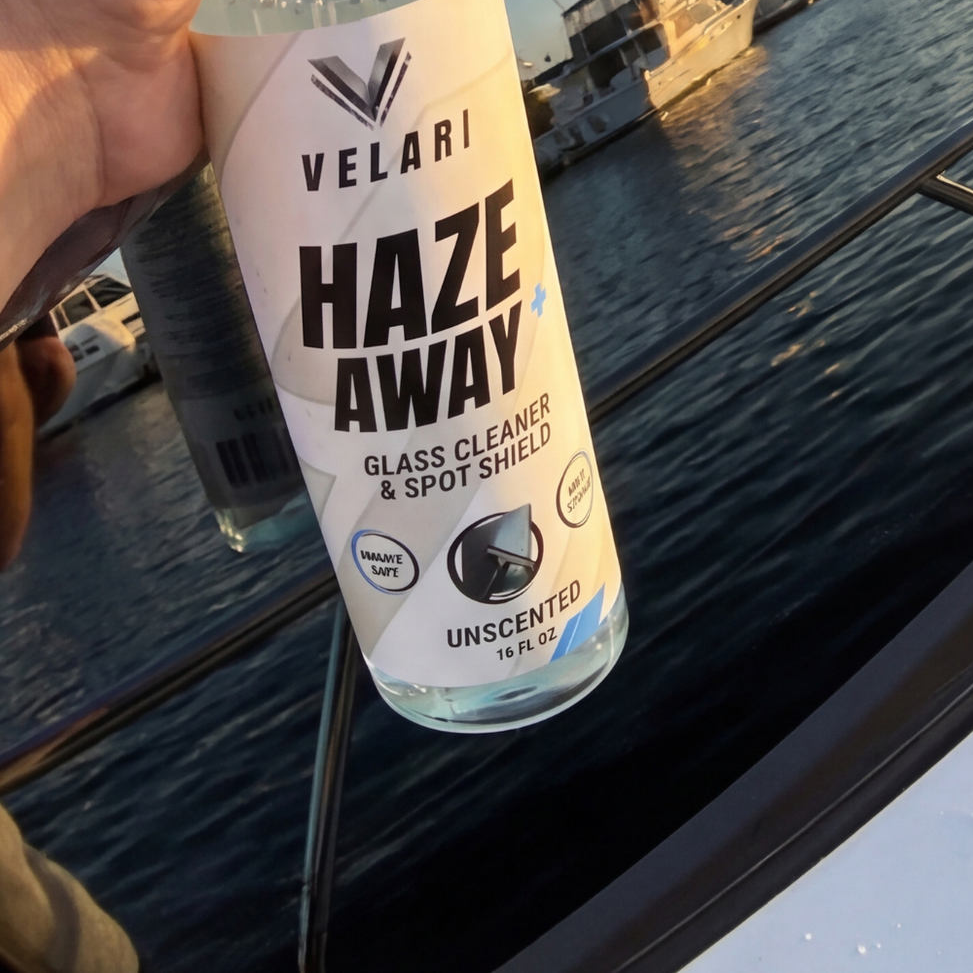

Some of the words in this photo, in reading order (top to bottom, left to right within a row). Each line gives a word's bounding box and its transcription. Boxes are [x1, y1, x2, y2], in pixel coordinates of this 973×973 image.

[301, 108, 470, 192] VELARI
[299, 178, 521, 349] HAZE
[334, 300, 523, 433] AWAY
[364, 446, 446, 476] GLASS
[453, 392, 551, 462] CLEANER
[380, 480, 397, 500] &
[404, 463, 472, 498] SPOT
[478, 421, 552, 480] SHIELD
[447, 579, 581, 648] UNSCENTED
[496, 647, 515, 661] 16
[518, 639, 535, 655] FL
[538, 627, 558, 645] OZ
